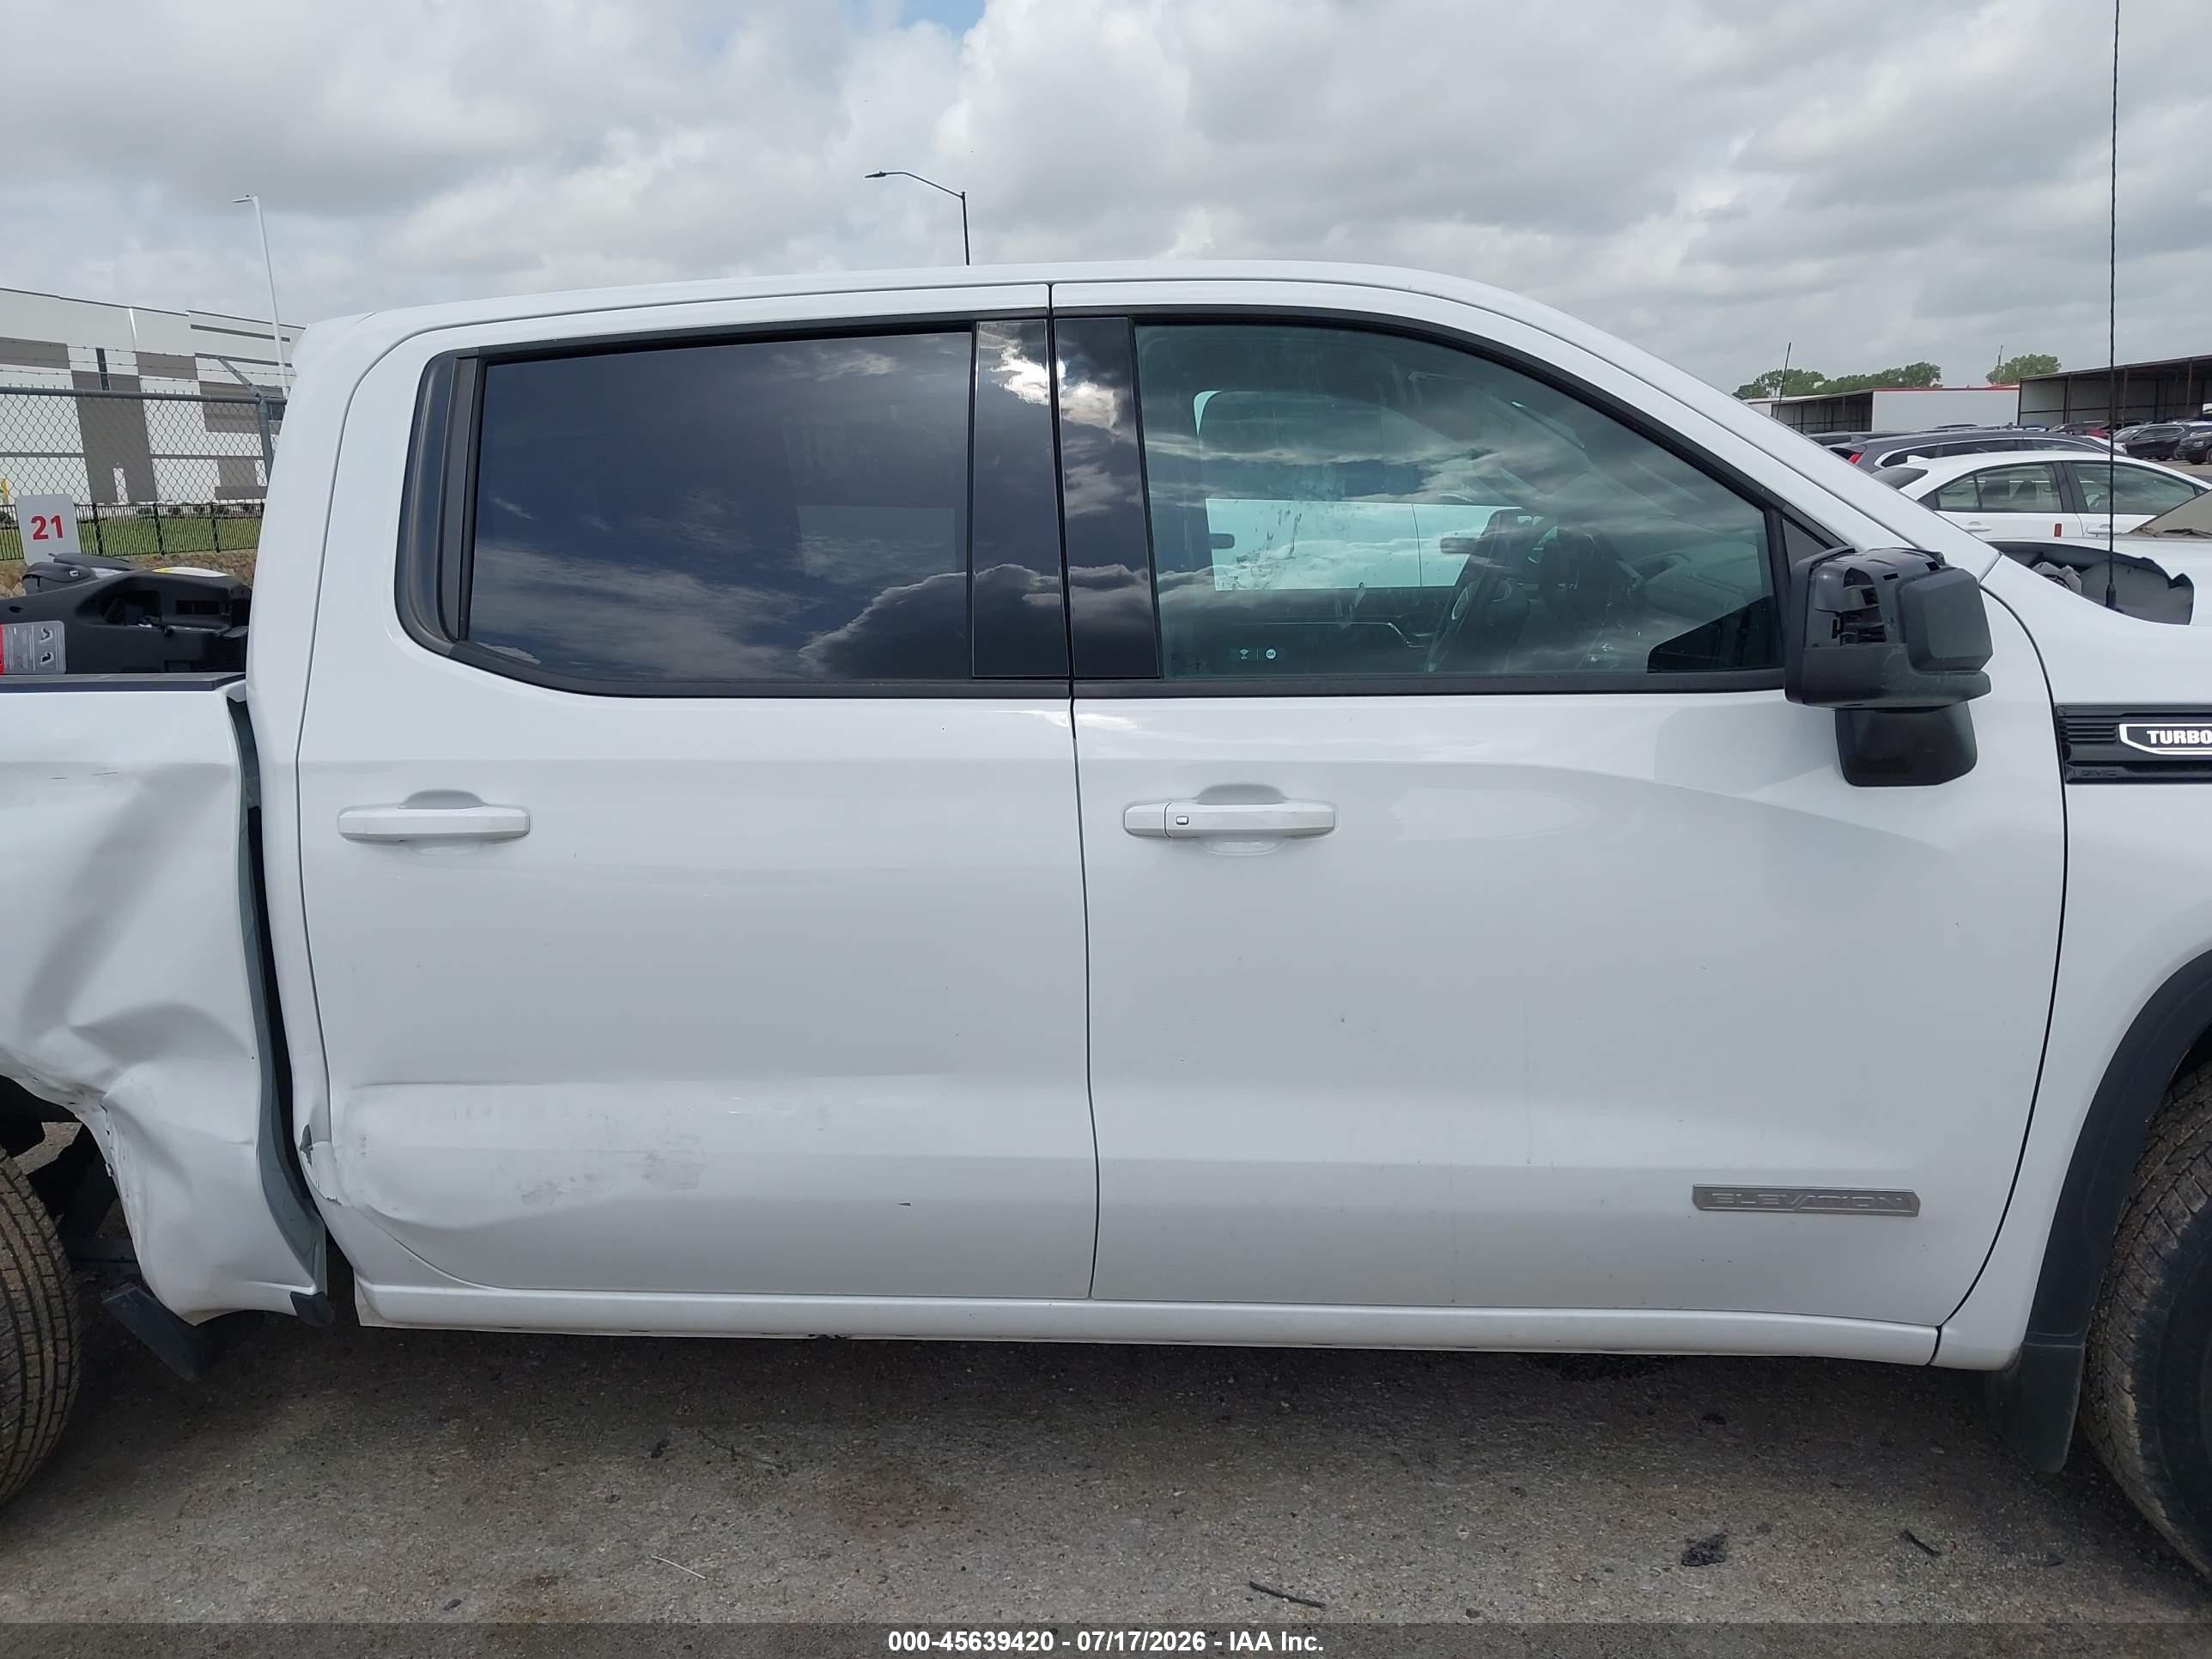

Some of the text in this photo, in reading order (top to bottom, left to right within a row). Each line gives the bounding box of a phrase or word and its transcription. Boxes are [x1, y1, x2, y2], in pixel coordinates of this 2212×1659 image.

[30, 514, 64, 540] 21
[2146, 730, 2212, 744] TURBO
[1711, 1192, 1905, 1209] ELEVATION
